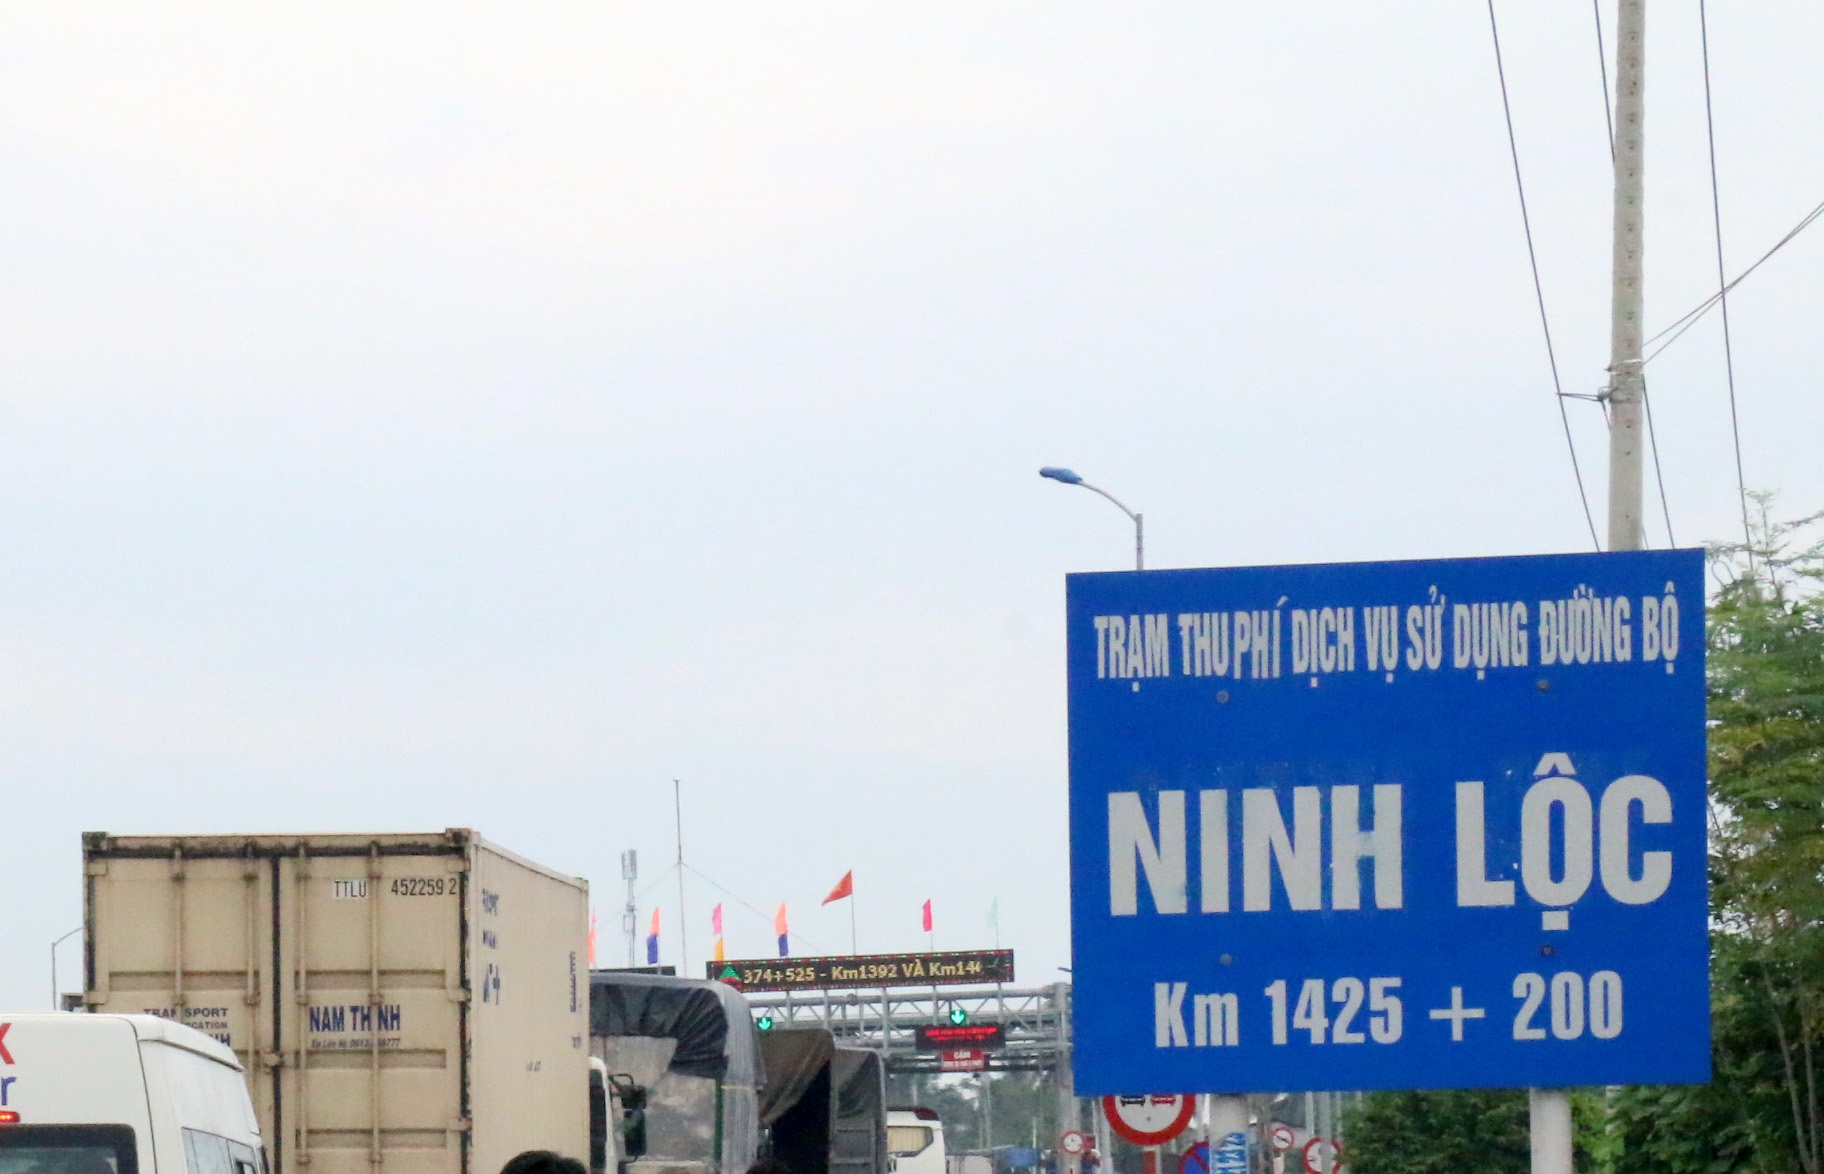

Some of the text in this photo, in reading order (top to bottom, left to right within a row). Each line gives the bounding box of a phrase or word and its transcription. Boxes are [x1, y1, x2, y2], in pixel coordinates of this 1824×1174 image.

[1094, 581, 1679, 692] TRẠM THU PHÍ DỊCH VỤ SỬ DỤNG ĐƯỜNG BỘ
[1109, 753, 1673, 931] NINH LỘC
[334, 877, 457, 898] TTLU 452259 2
[831, 964, 897, 980] Km1392
[902, 958, 925, 977] VÀ
[309, 1004, 401, 1032] NAM THNH
[1154, 970, 1623, 1048] Km 1425 + 200
